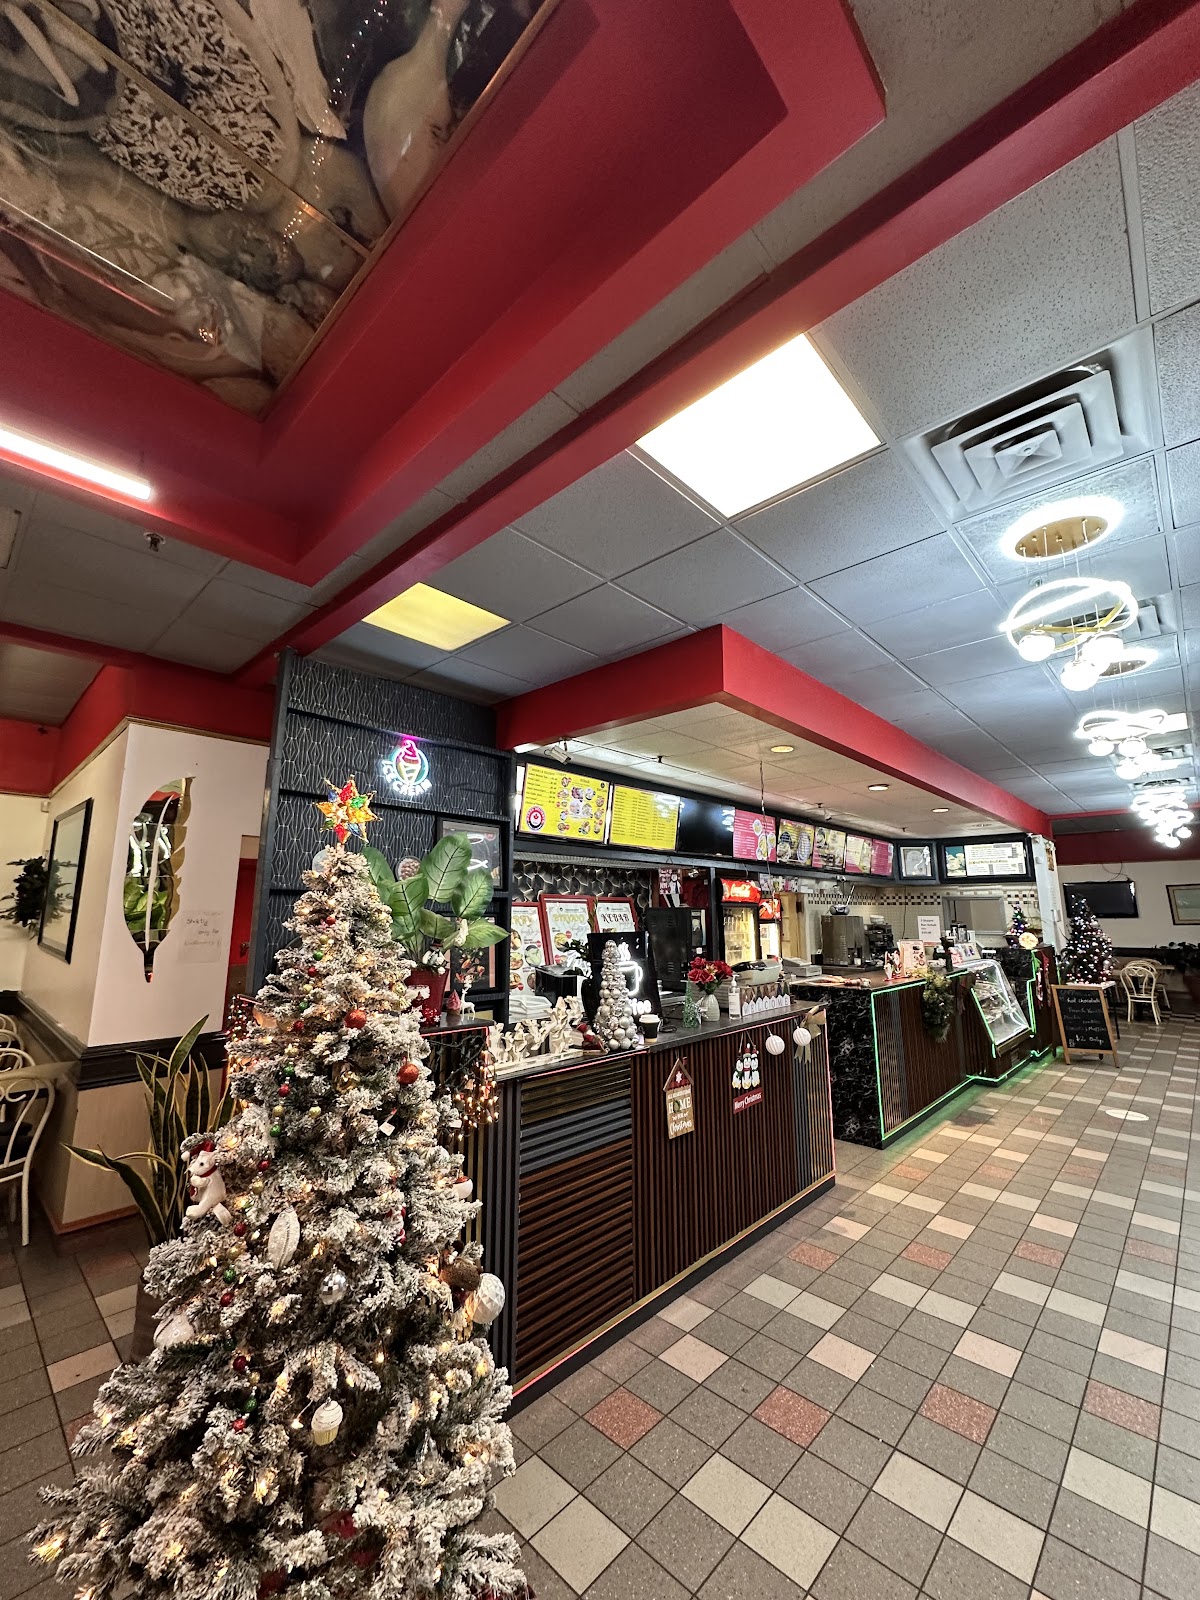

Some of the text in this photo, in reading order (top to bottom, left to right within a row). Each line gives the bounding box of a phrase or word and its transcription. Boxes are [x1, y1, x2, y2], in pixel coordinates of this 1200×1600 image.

[392, 779, 433, 796] CREAM
[601, 913, 630, 923] KEBAB
[743, 996, 789, 1014] WELCOME
[668, 1097, 692, 1114] HOME
[734, 1092, 762, 1111] Merry Christmas
